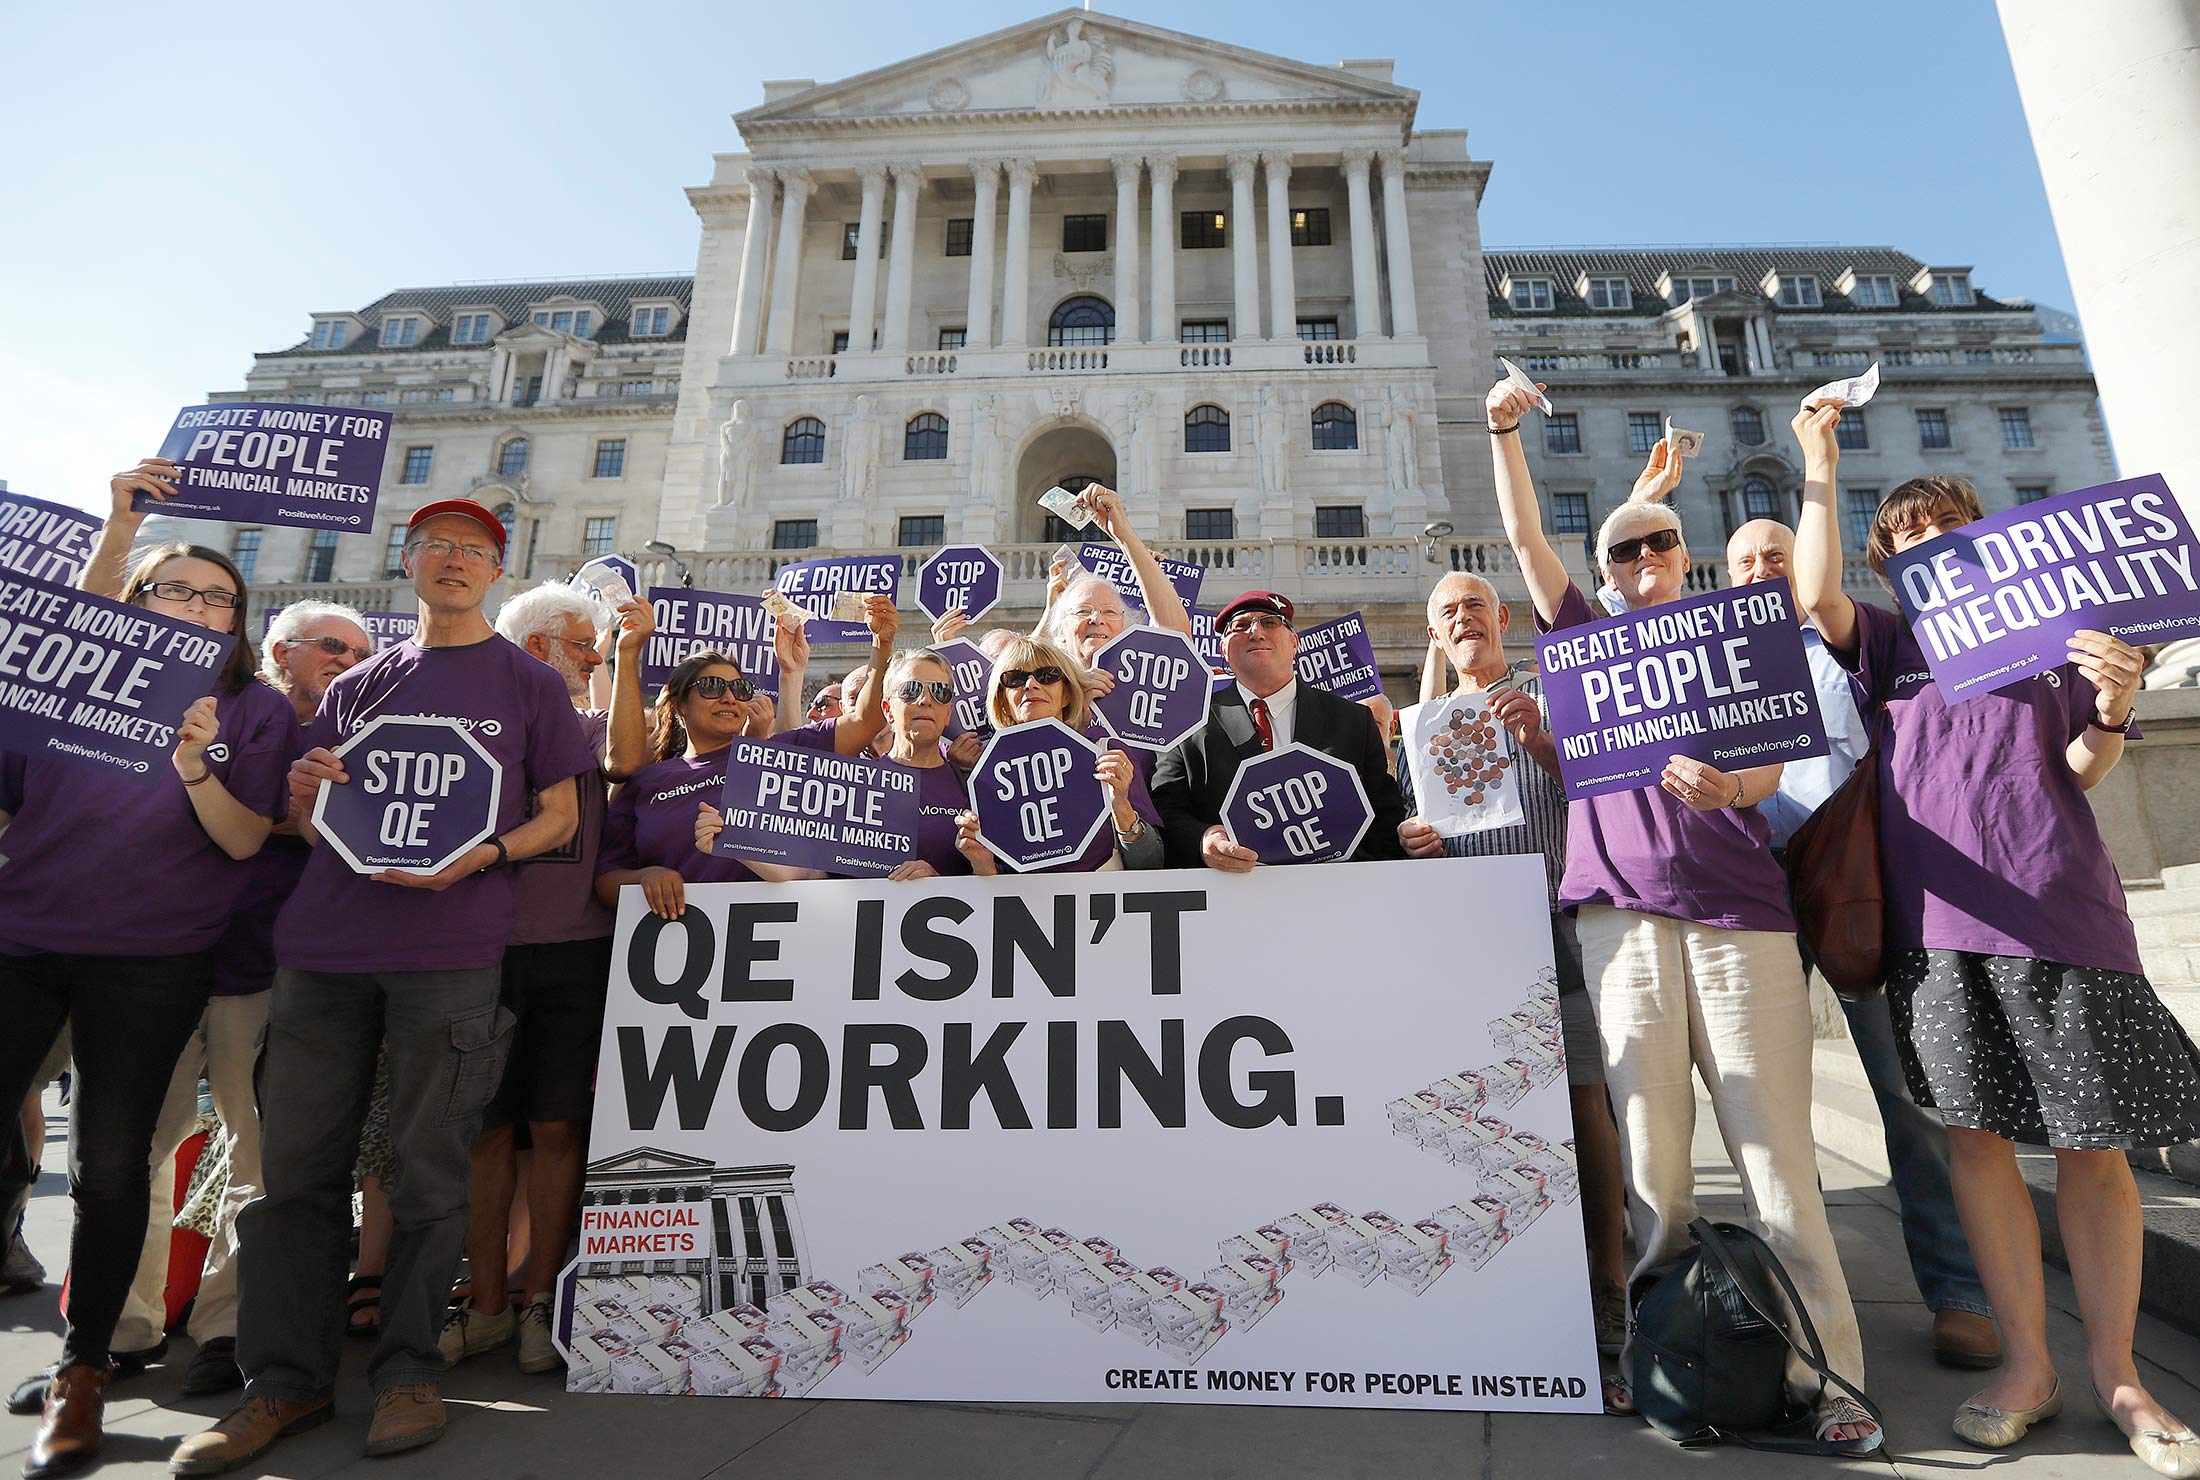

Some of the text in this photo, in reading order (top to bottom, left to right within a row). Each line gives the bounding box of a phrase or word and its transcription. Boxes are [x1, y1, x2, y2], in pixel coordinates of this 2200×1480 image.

[177, 409, 383, 440] CREATE MONEY FOR
[184, 429, 344, 478] PEOPLE
[188, 467, 282, 496] FINANCIAL
[285, 477, 370, 504] MARKETS
[277, 508, 348, 523] PositiveMoney
[1901, 491, 2179, 613] QE DRIVES
[776, 563, 895, 594] QE DRIVES
[935, 561, 986, 586] STOP
[1175, 565, 1200, 579] FOR
[945, 587, 971, 610] QE
[1920, 544, 2199, 662] INEQUALITY
[63, 602, 168, 651] MONEY
[163, 630, 223, 669] FOR
[388, 618, 417, 635] FOR
[653, 598, 689, 635] QE
[694, 602, 776, 643] DRIVE
[1297, 618, 1361, 654] MONEY FOR
[1542, 590, 1787, 674] CREATE MONEY FOR
[1117, 648, 1189, 692] STOP
[1333, 664, 1374, 690] MARKETS
[1580, 636, 1760, 724] PEOPLE
[1953, 653, 2040, 692] positivemoney.org.uk
[67, 702, 175, 748] MARKETS
[955, 696, 987, 731] QE
[1129, 690, 1167, 729] QE
[1562, 690, 1810, 762] NOT FINANCIAL MARKETS
[47, 738, 133, 770] PositiveMoney
[1121, 730, 1159, 744] PositiveMoney
[1712, 738, 1797, 761] PositiveMoney
[363, 749, 466, 797] STOP
[736, 742, 915, 793] CREATE MONEY FOR
[993, 747, 1073, 803] STOP
[1575, 765, 1652, 789] positivemoney.org.uk
[756, 771, 886, 827] PEOPLE
[1246, 770, 1328, 830] STOP
[379, 801, 436, 848] QE
[724, 807, 911, 853] NOT FINANCIAL MARKETS
[1019, 795, 1064, 843] QE
[1282, 816, 1331, 857] QE
[365, 855, 422, 865] PositiveMoney
[722, 841, 787, 857] positivemoney.org.uk
[835, 855, 895, 873] PositiveMoney
[1021, 847, 1064, 862] PositiveMoney
[626, 890, 1208, 1020] QE ISN'T
[616, 1014, 1345, 1131] WORKING.
[583, 1208, 700, 1231] FINANCIAL
[586, 1232, 694, 1255] MARKETS
[1104, 1368, 1587, 1399] CREATE MONEY FOR PEOPLE INSTEAD
